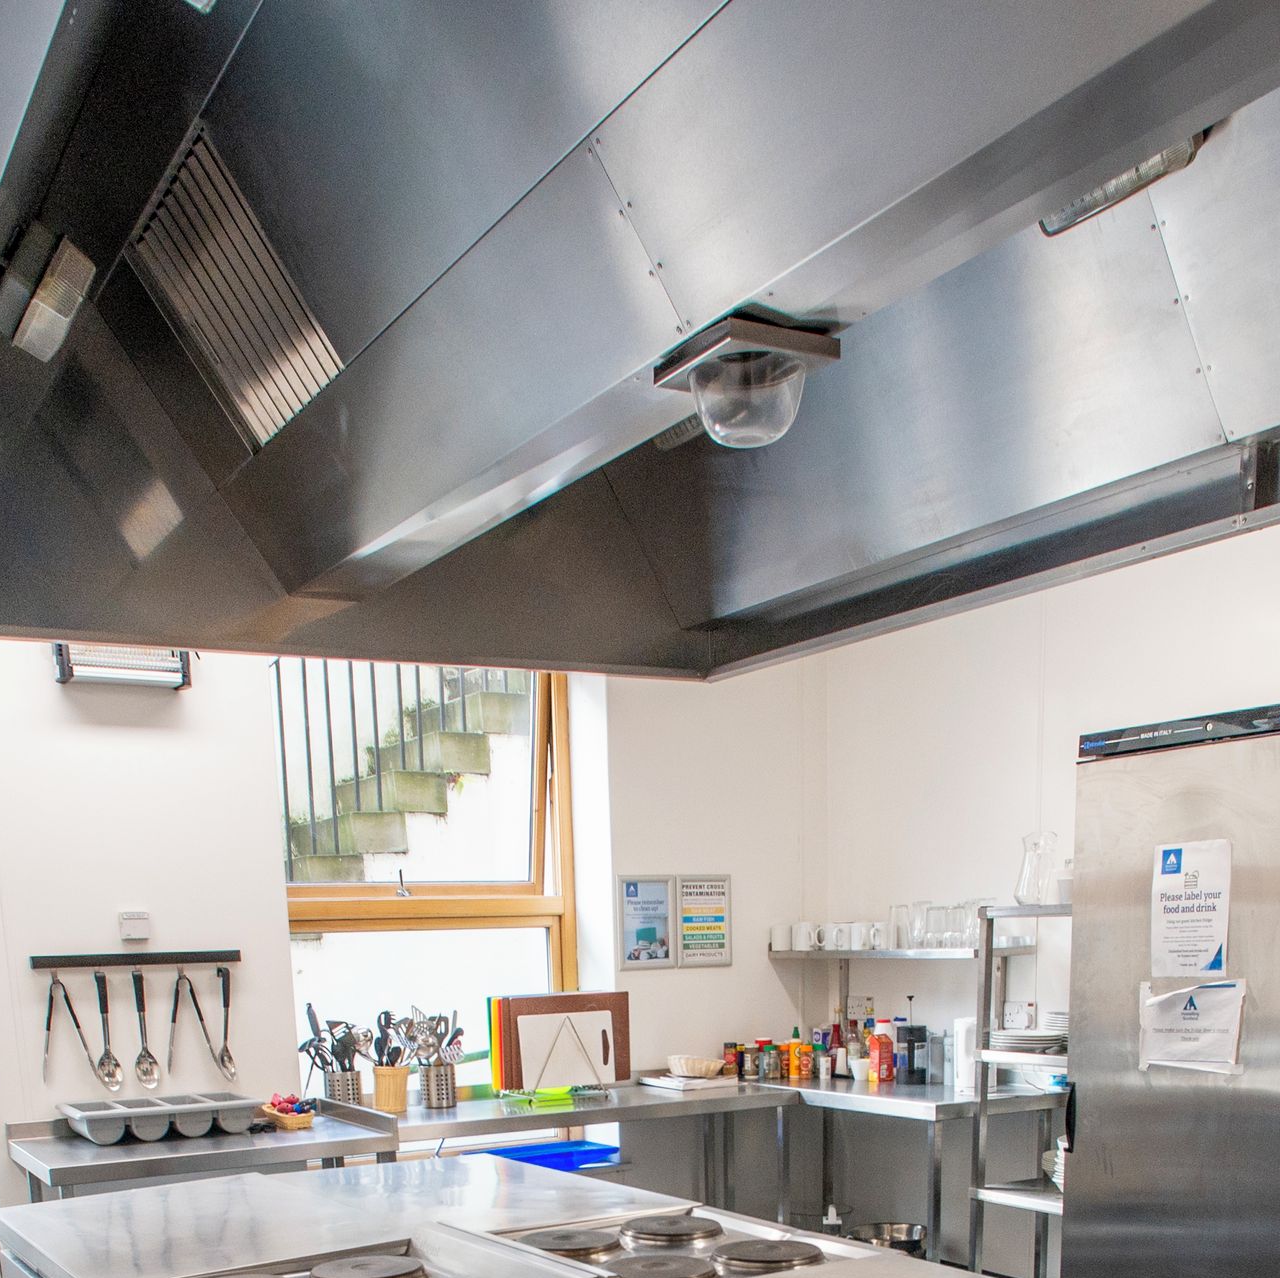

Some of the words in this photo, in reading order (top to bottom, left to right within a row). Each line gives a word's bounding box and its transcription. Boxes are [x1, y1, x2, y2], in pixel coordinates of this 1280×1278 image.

[1160, 892, 1183, 903] Please
[1183, 890, 1203, 901] label
[1203, 890, 1222, 903] your
[1163, 904, 1180, 915] food
[1180, 903, 1195, 914] and
[1195, 902, 1217, 913] drink
